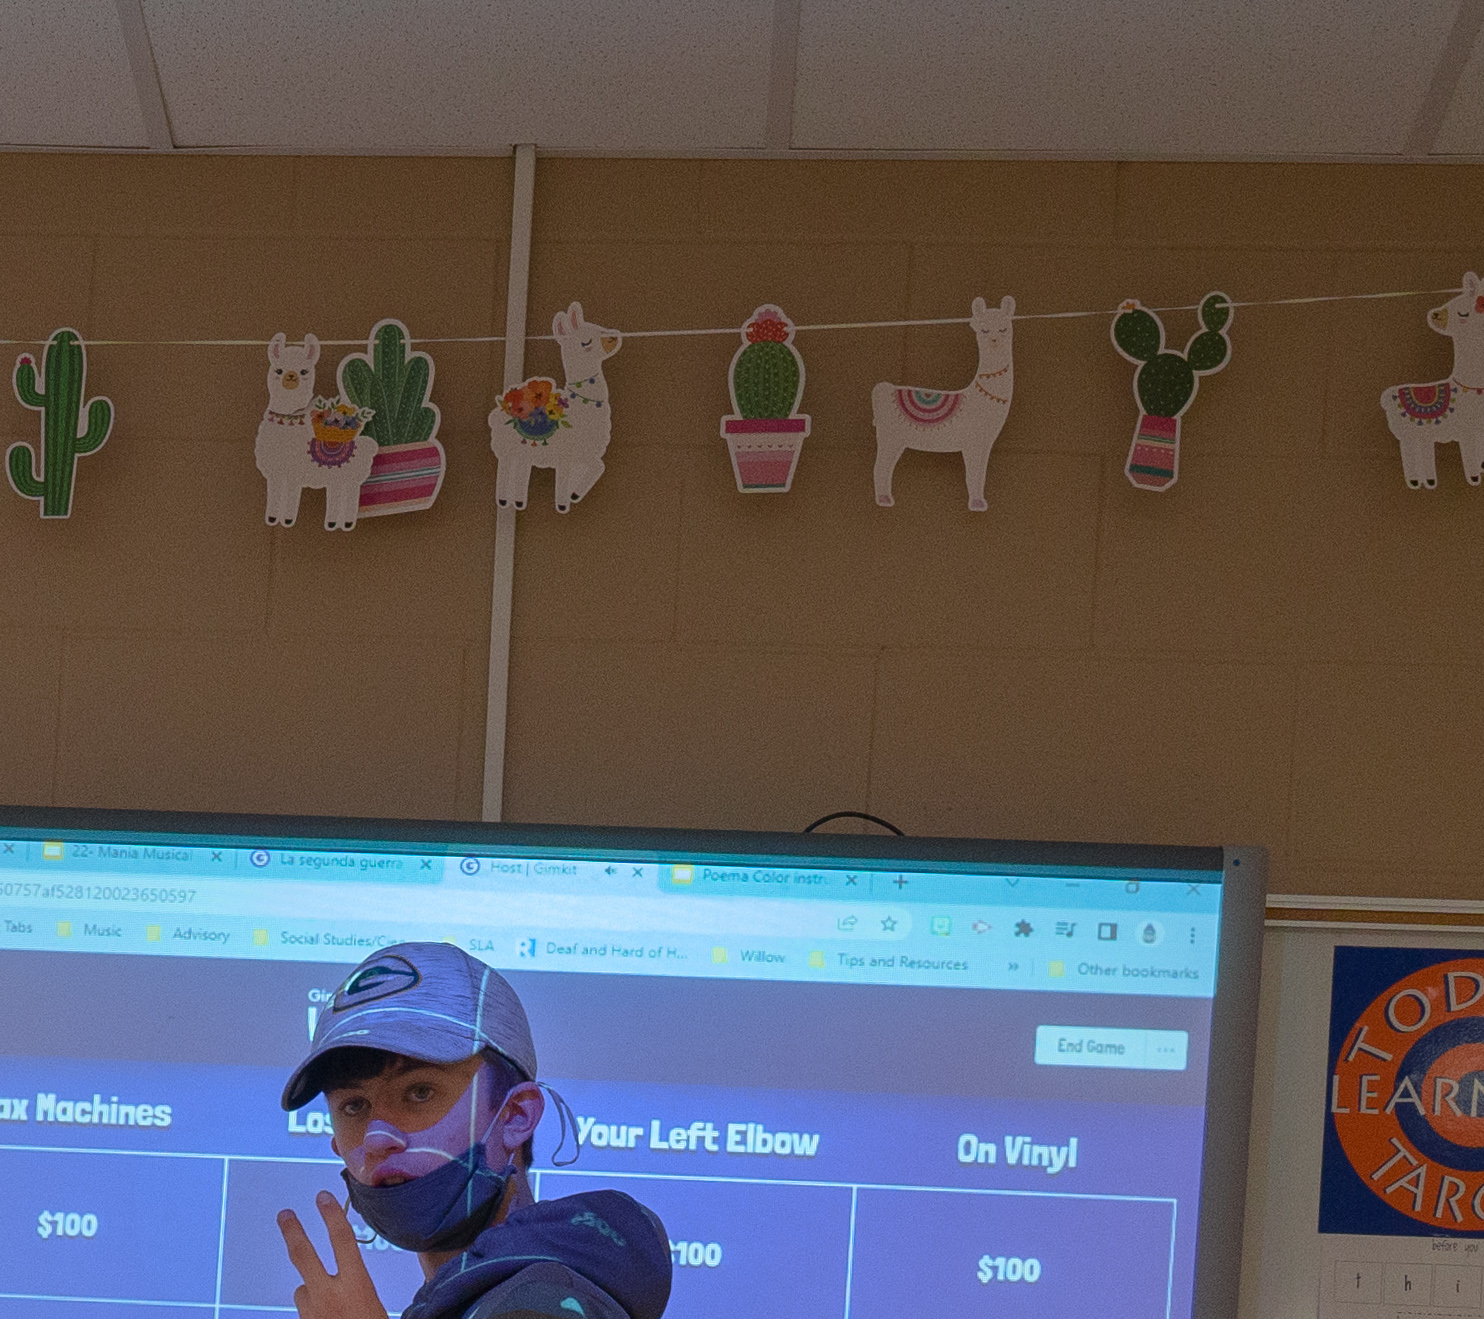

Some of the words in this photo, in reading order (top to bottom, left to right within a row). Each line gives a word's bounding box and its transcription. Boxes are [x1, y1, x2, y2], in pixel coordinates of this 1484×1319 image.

[299, 855, 355, 871] segunda
[491, 862, 522, 875] Host
[534, 863, 577, 877] Gimkit
[703, 868, 749, 883] Poema
[753, 869, 790, 884] Color
[4, 920, 33, 934] Tabs
[84, 923, 122, 937] Music
[173, 926, 230, 943] Advisory
[281, 930, 319, 945] Social
[469, 938, 495, 952] SLA
[546, 941, 578, 956] Deaf
[582, 943, 607, 957] and
[612, 944, 644, 959] Hard
[648, 944, 664, 959] of
[741, 949, 786, 964] Willow
[837, 952, 865, 969] Tips
[869, 953, 895, 969] and
[899, 955, 969, 972] Resources
[1077, 961, 1118, 977] Other
[1122, 964, 1200, 980] bookmarks
[1058, 1037, 1083, 1054] End
[1087, 1039, 1126, 1056] Game
[36, 1092, 172, 1128] Machines
[577, 1115, 643, 1148] Your
[649, 1119, 720, 1152] Left
[726, 1122, 820, 1157] Elbow
[957, 1132, 997, 1164] On
[1004, 1134, 1078, 1174] Vinyl
[37, 1209, 98, 1240] $100
[977, 1255, 1041, 1284] $100
